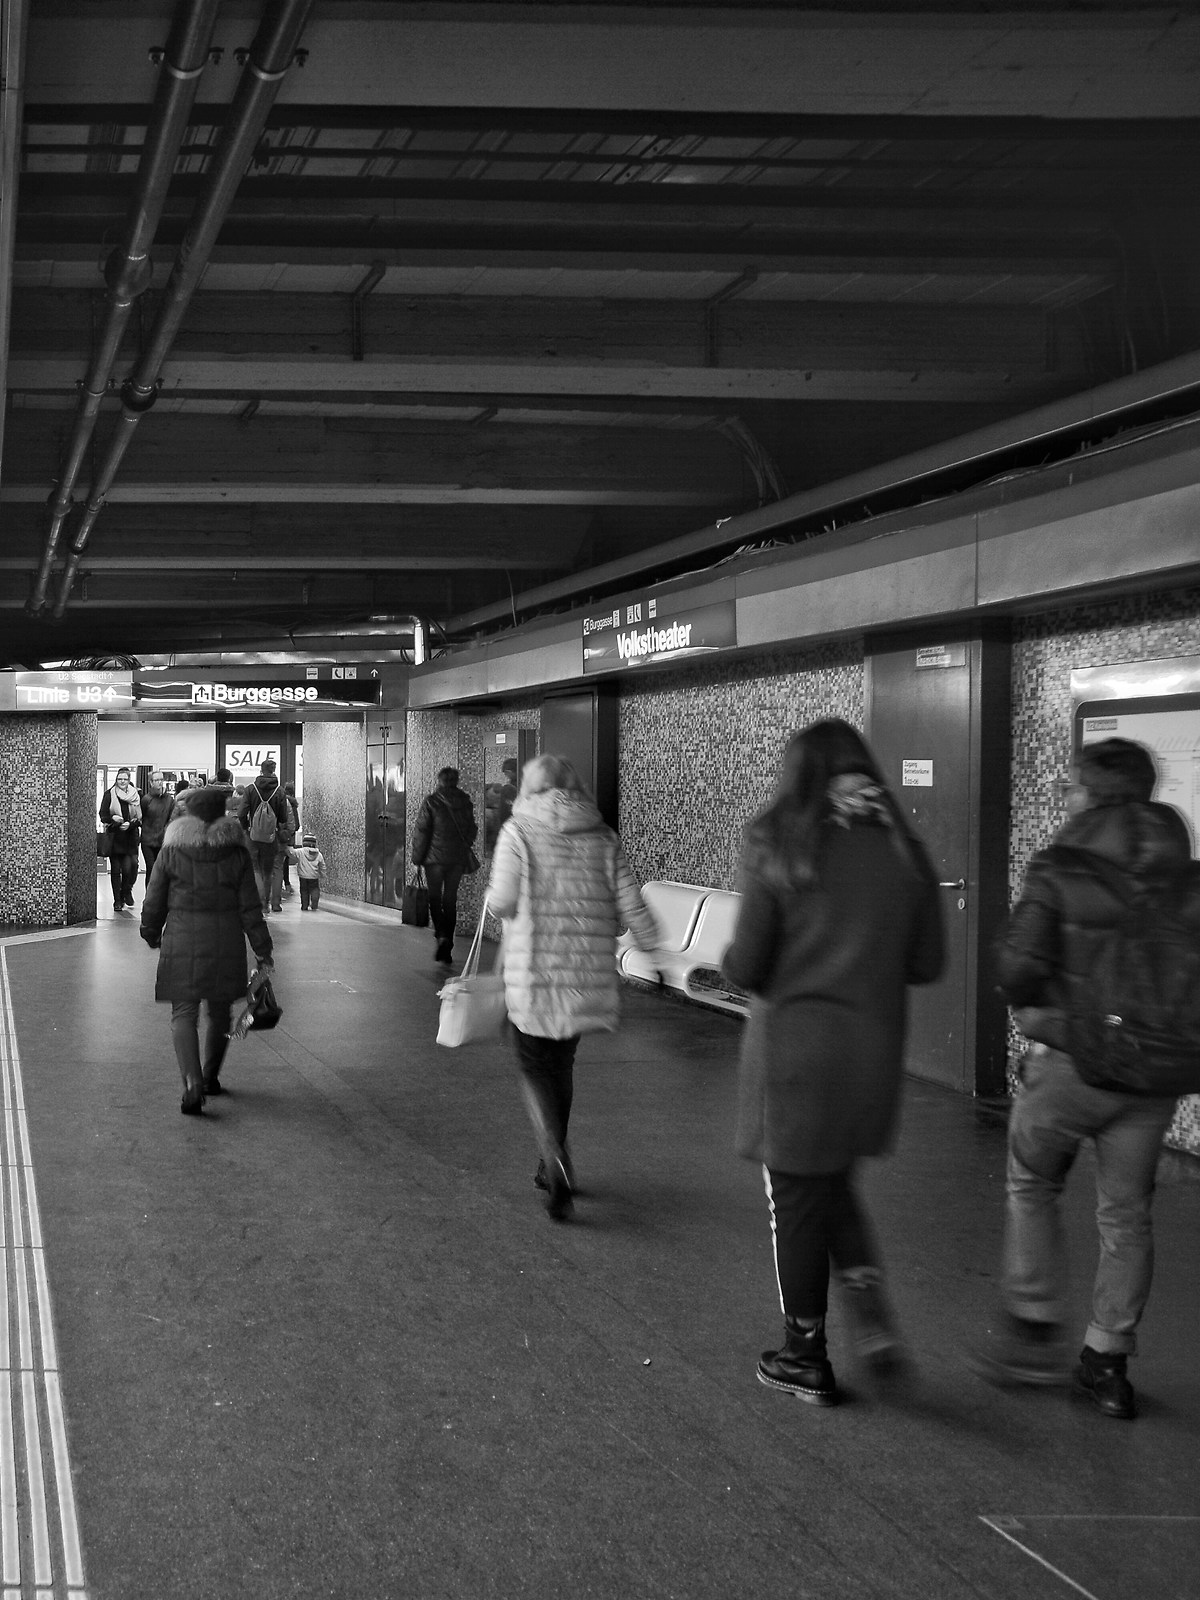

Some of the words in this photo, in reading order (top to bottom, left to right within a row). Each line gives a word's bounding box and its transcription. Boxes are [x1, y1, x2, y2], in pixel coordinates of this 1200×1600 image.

[589, 616, 613, 631] Burggasse
[616, 621, 692, 660] Volkstheater
[58, 672, 69, 681] U2
[27, 686, 70, 703] Linie
[77, 686, 102, 703] U3
[214, 684, 319, 704] Burggasse
[229, 750, 277, 767] SALE
